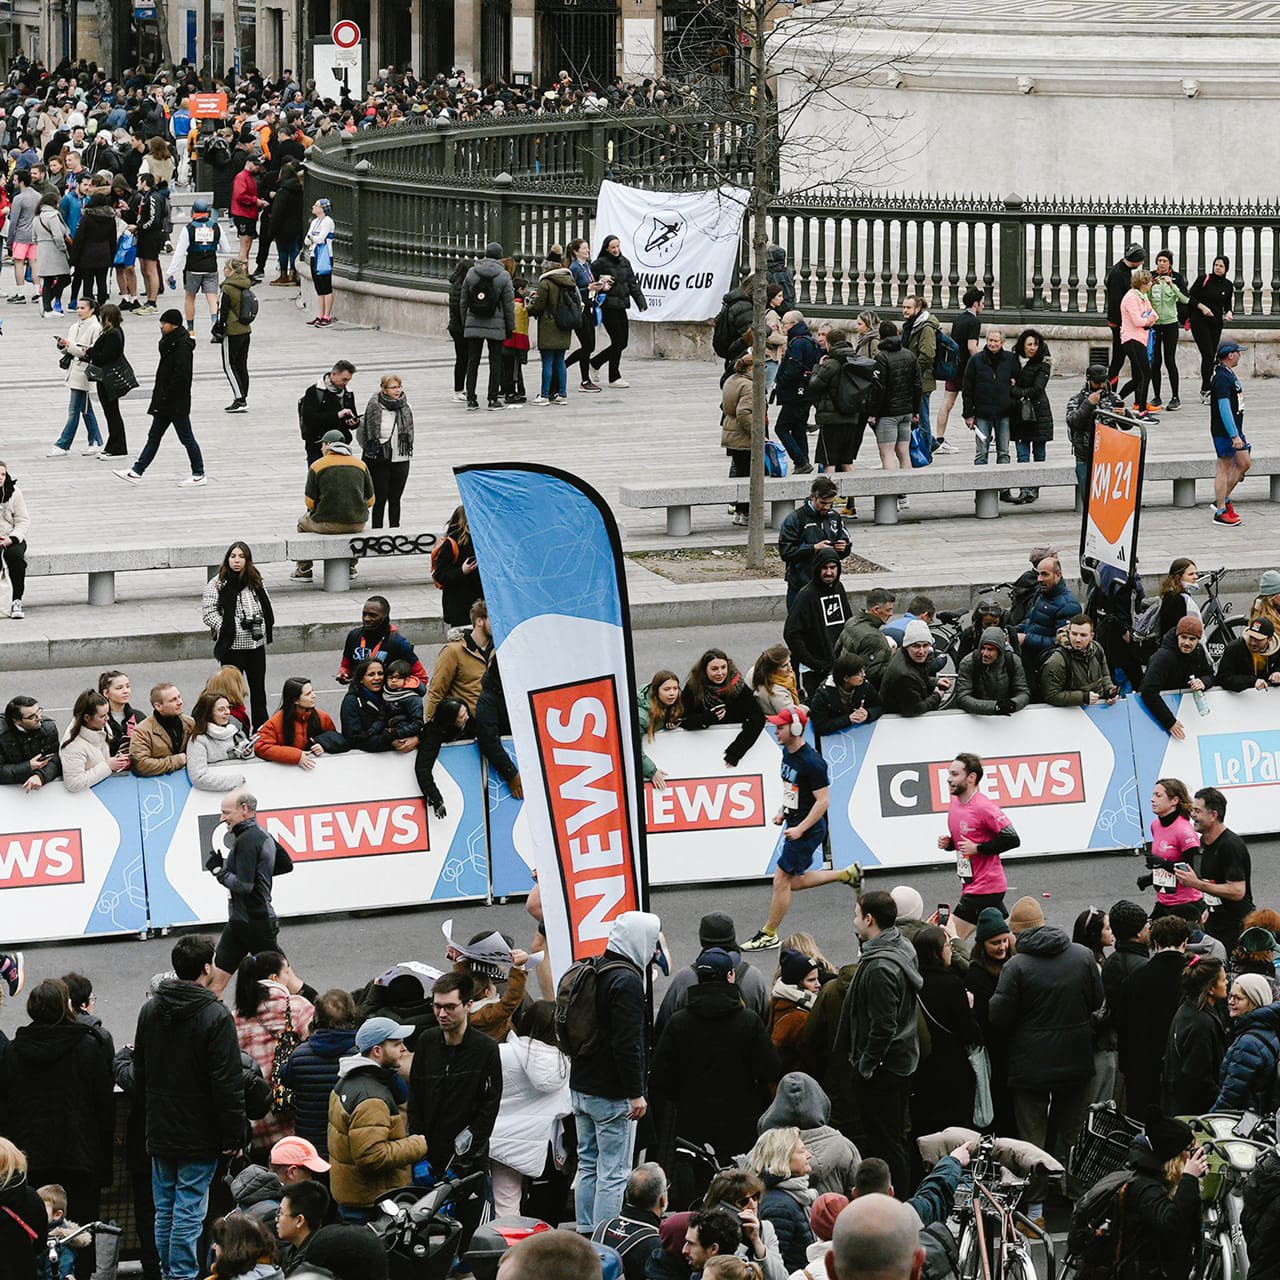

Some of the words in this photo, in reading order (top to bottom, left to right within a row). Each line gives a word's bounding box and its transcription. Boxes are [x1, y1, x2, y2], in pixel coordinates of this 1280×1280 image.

[1112, 461, 1132, 500] 21
[890, 770, 920, 808] C
[1214, 752, 1240, 785] Le
[546, 696, 627, 943] NEWS
[646, 781, 756, 825] EWS
[263, 805, 419, 854] NEWS
